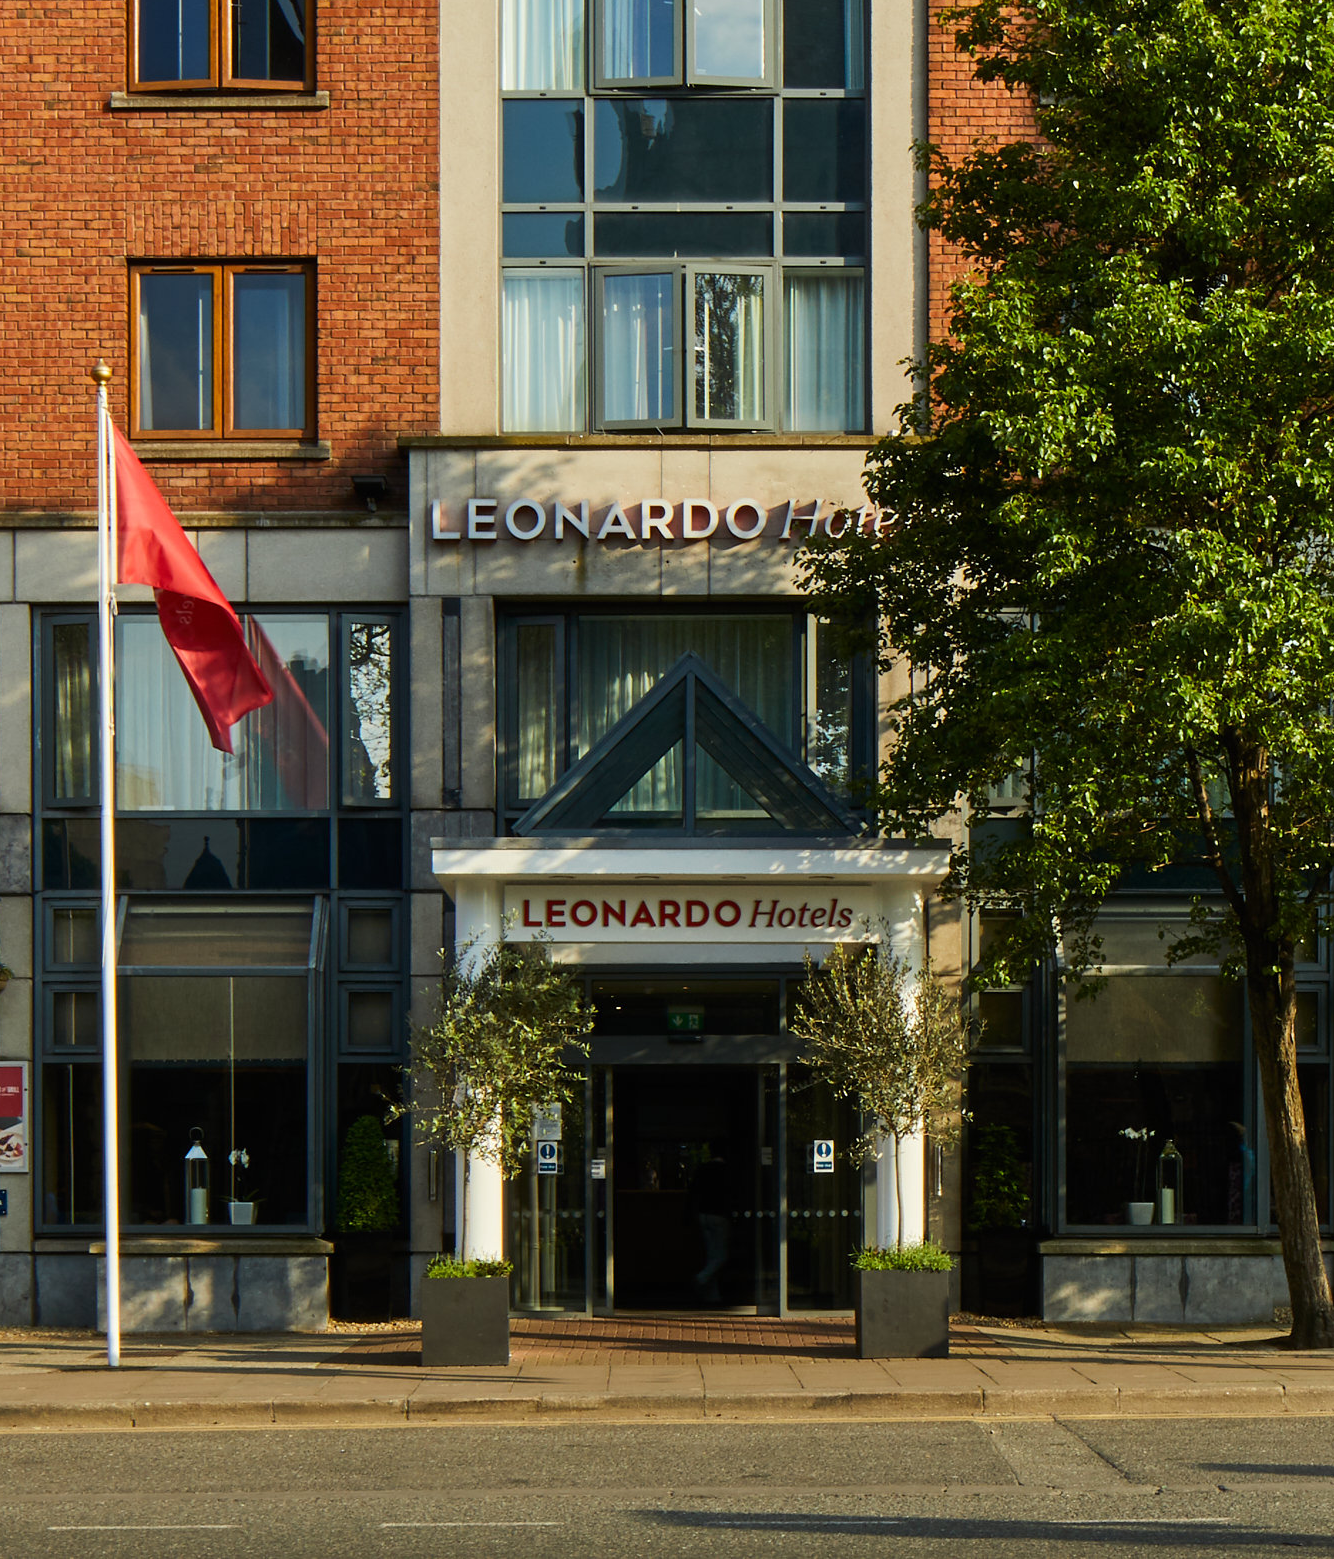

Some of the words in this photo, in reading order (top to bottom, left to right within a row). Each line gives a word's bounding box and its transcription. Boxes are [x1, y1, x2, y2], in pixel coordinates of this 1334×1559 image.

[431, 497, 768, 541] LEONARDO
[778, 497, 900, 540] Hote
[522, 899, 742, 928] LEONARDO
[748, 898, 854, 929] Hotels
